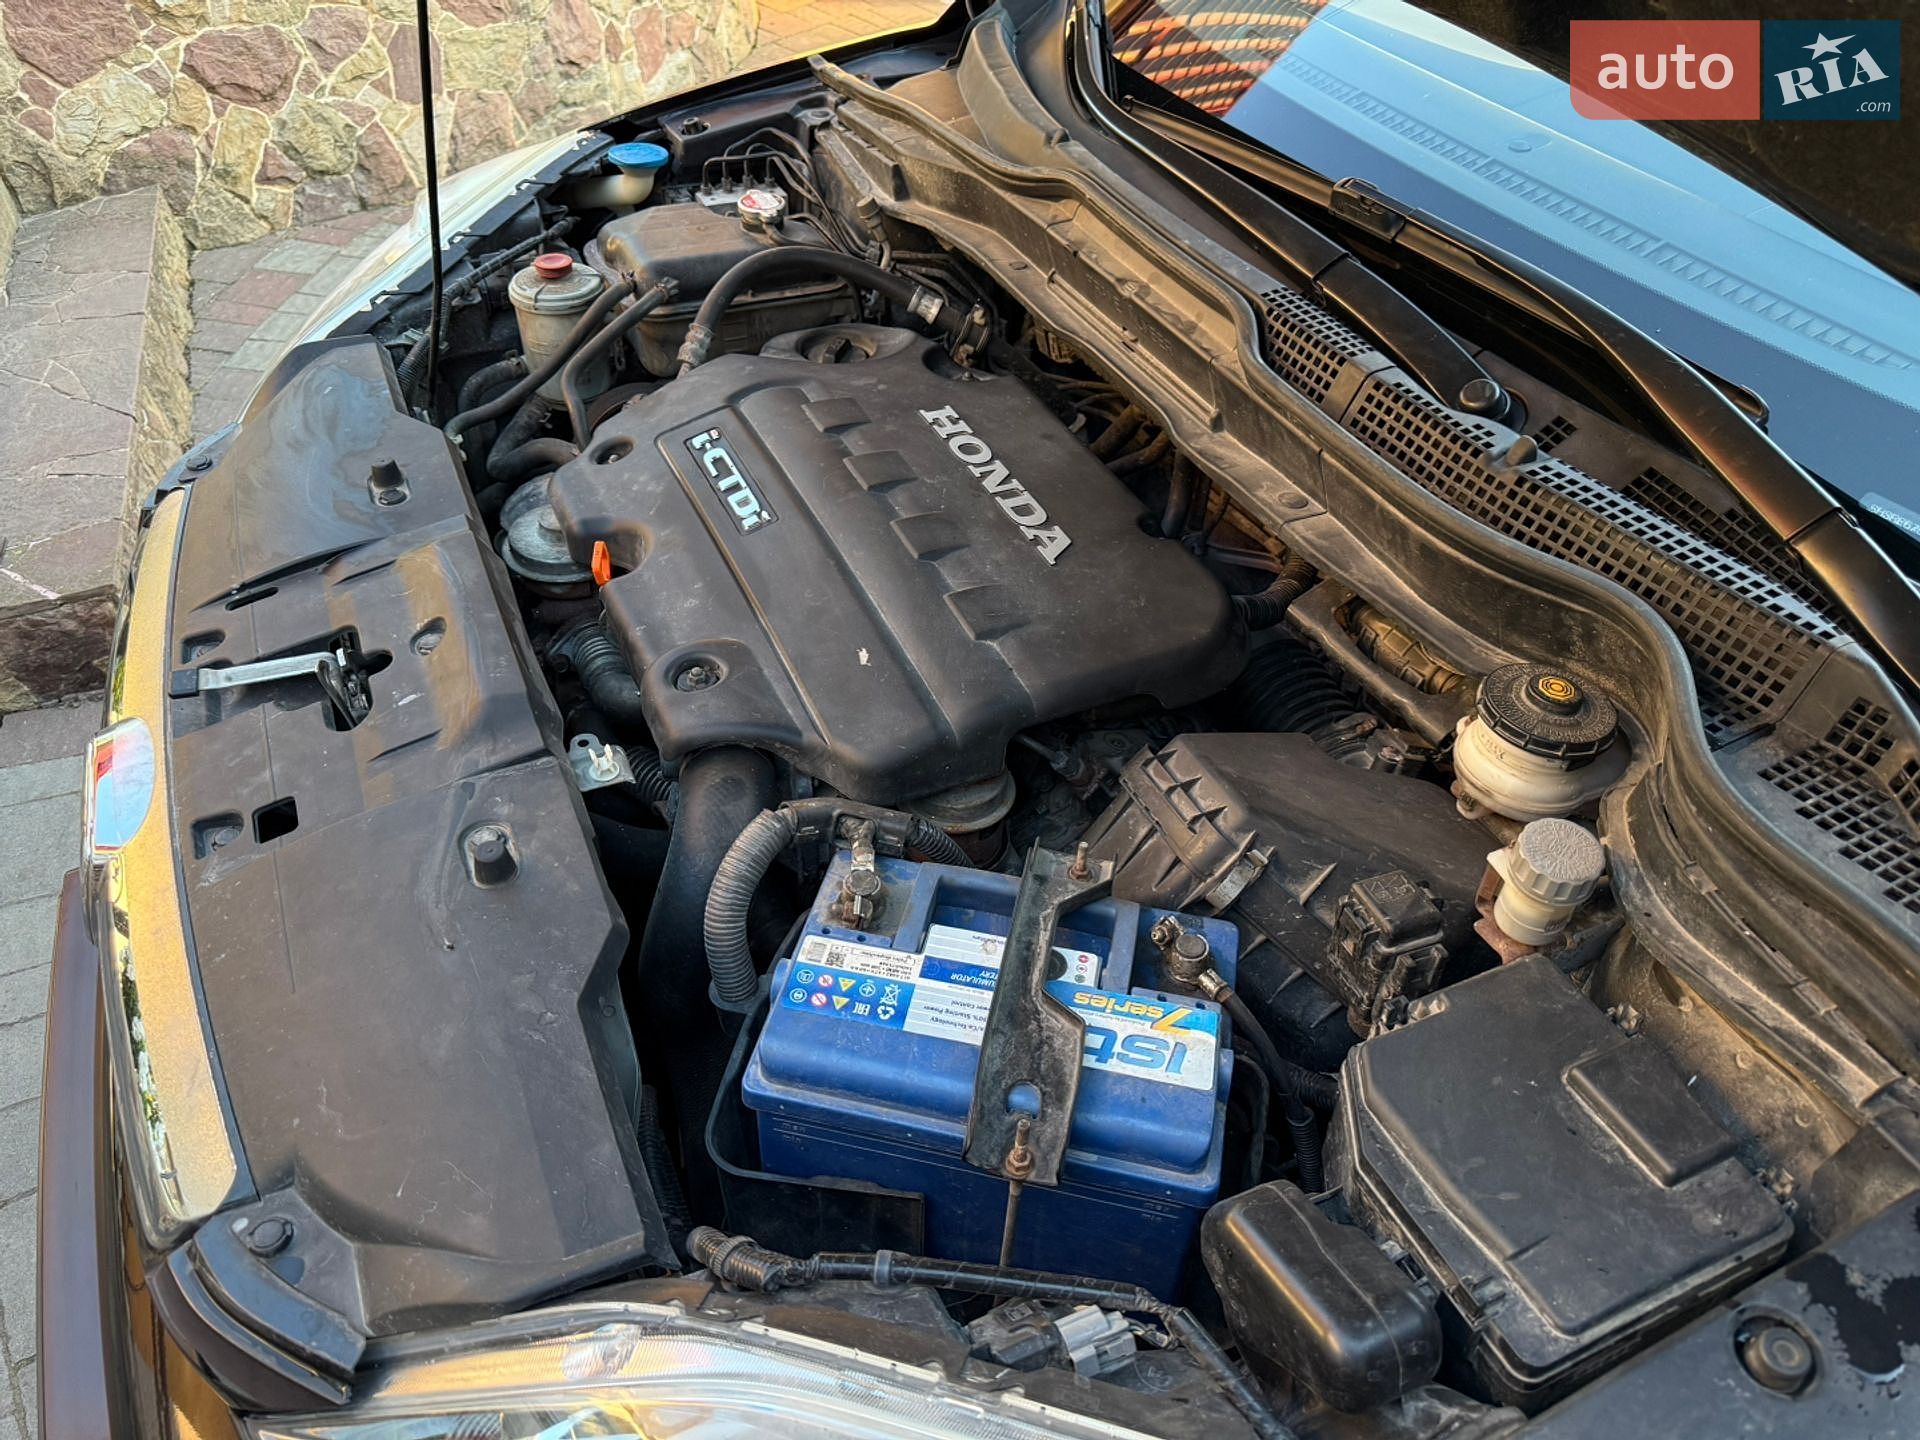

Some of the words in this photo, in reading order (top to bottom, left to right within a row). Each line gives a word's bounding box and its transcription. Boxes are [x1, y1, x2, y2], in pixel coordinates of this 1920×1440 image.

[918, 405, 1072, 566] HONDA
[1073, 991, 1164, 1018] series
[1151, 1007, 1193, 1037] 7
